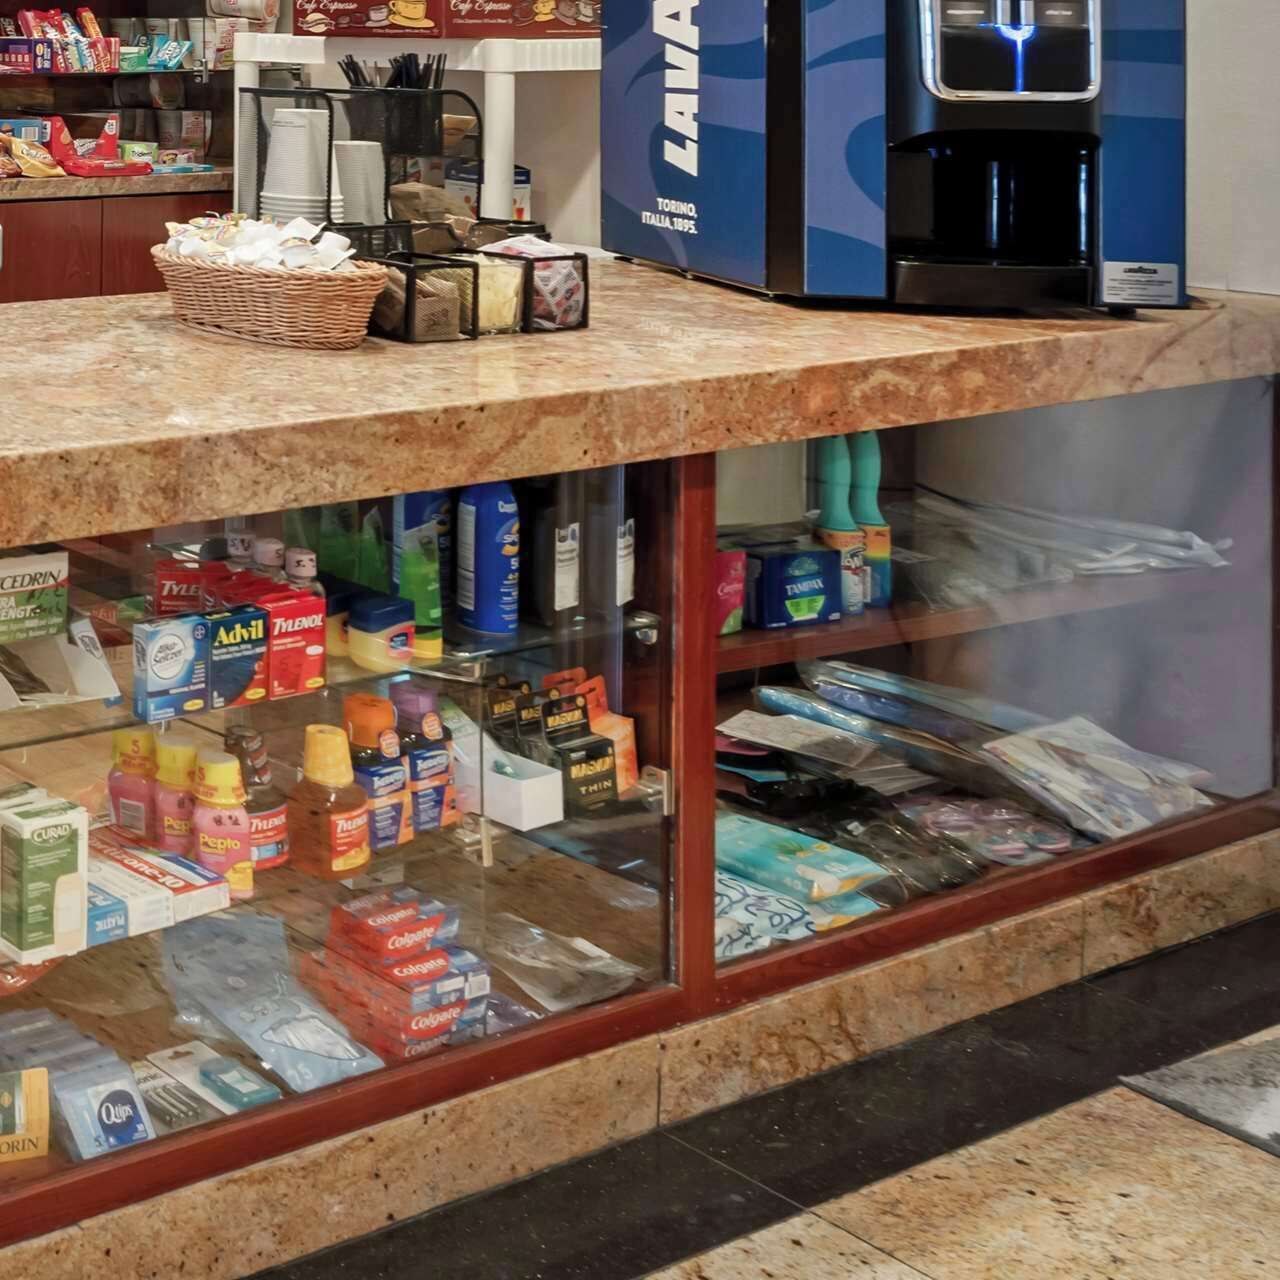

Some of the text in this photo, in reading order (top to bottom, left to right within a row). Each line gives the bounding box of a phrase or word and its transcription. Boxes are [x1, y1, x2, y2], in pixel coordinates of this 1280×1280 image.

[656, 197, 698, 219] TORINO,
[161, 580, 201, 597] TYLE
[785, 578, 824, 596] TAMPAX
[214, 618, 264, 646] Advil
[272, 613, 323, 636] TYLENOL
[570, 755, 614, 779] MAGNUM
[579, 779, 612, 795] THIN
[163, 815, 189, 831] Pep
[32, 824, 71, 843] CURAD
[199, 832, 241, 852] Pepto
[367, 907, 417, 926] Colgate
[387, 926, 436, 950] Colgate
[393, 957, 447, 976] Colgate
[410, 1006, 462, 1030] Colgate
